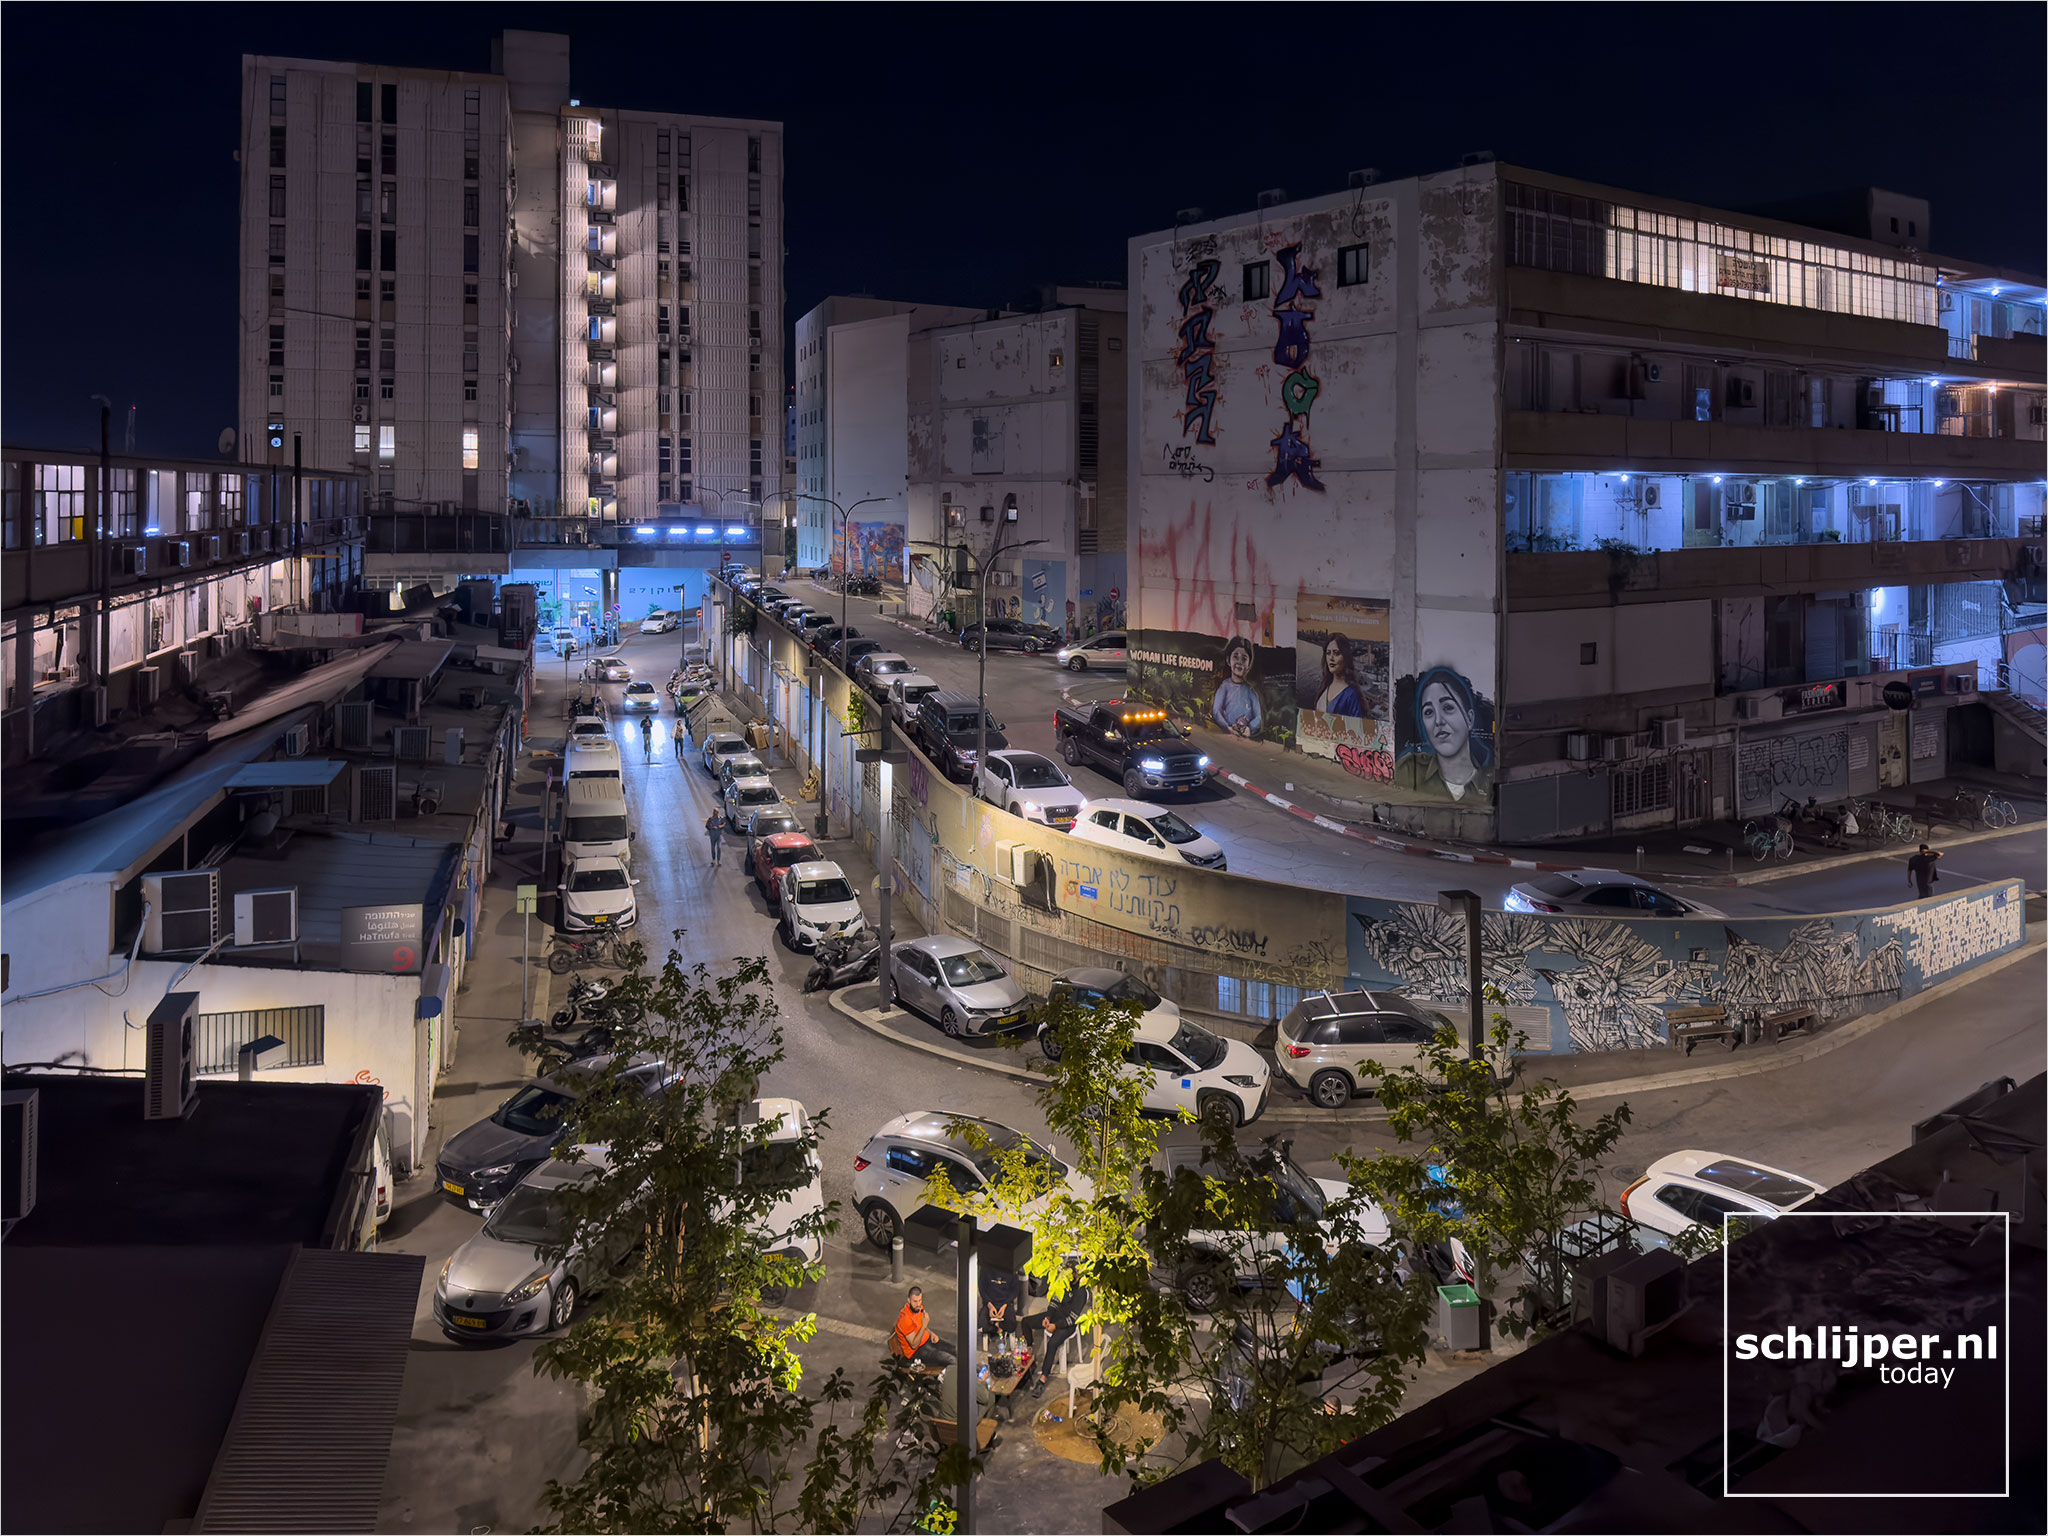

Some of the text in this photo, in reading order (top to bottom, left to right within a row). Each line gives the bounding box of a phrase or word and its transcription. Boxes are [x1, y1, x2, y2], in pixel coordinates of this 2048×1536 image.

[1129, 649, 1214, 672] WOMAN LIFE FREEDOM
[1060, 858, 1177, 897] עוד לא אבדה
[365, 911, 400, 920] התנופה
[1109, 891, 1180, 925] תקוותינו
[359, 931, 400, 941] HaTnufa
[392, 945, 415, 971] 9
